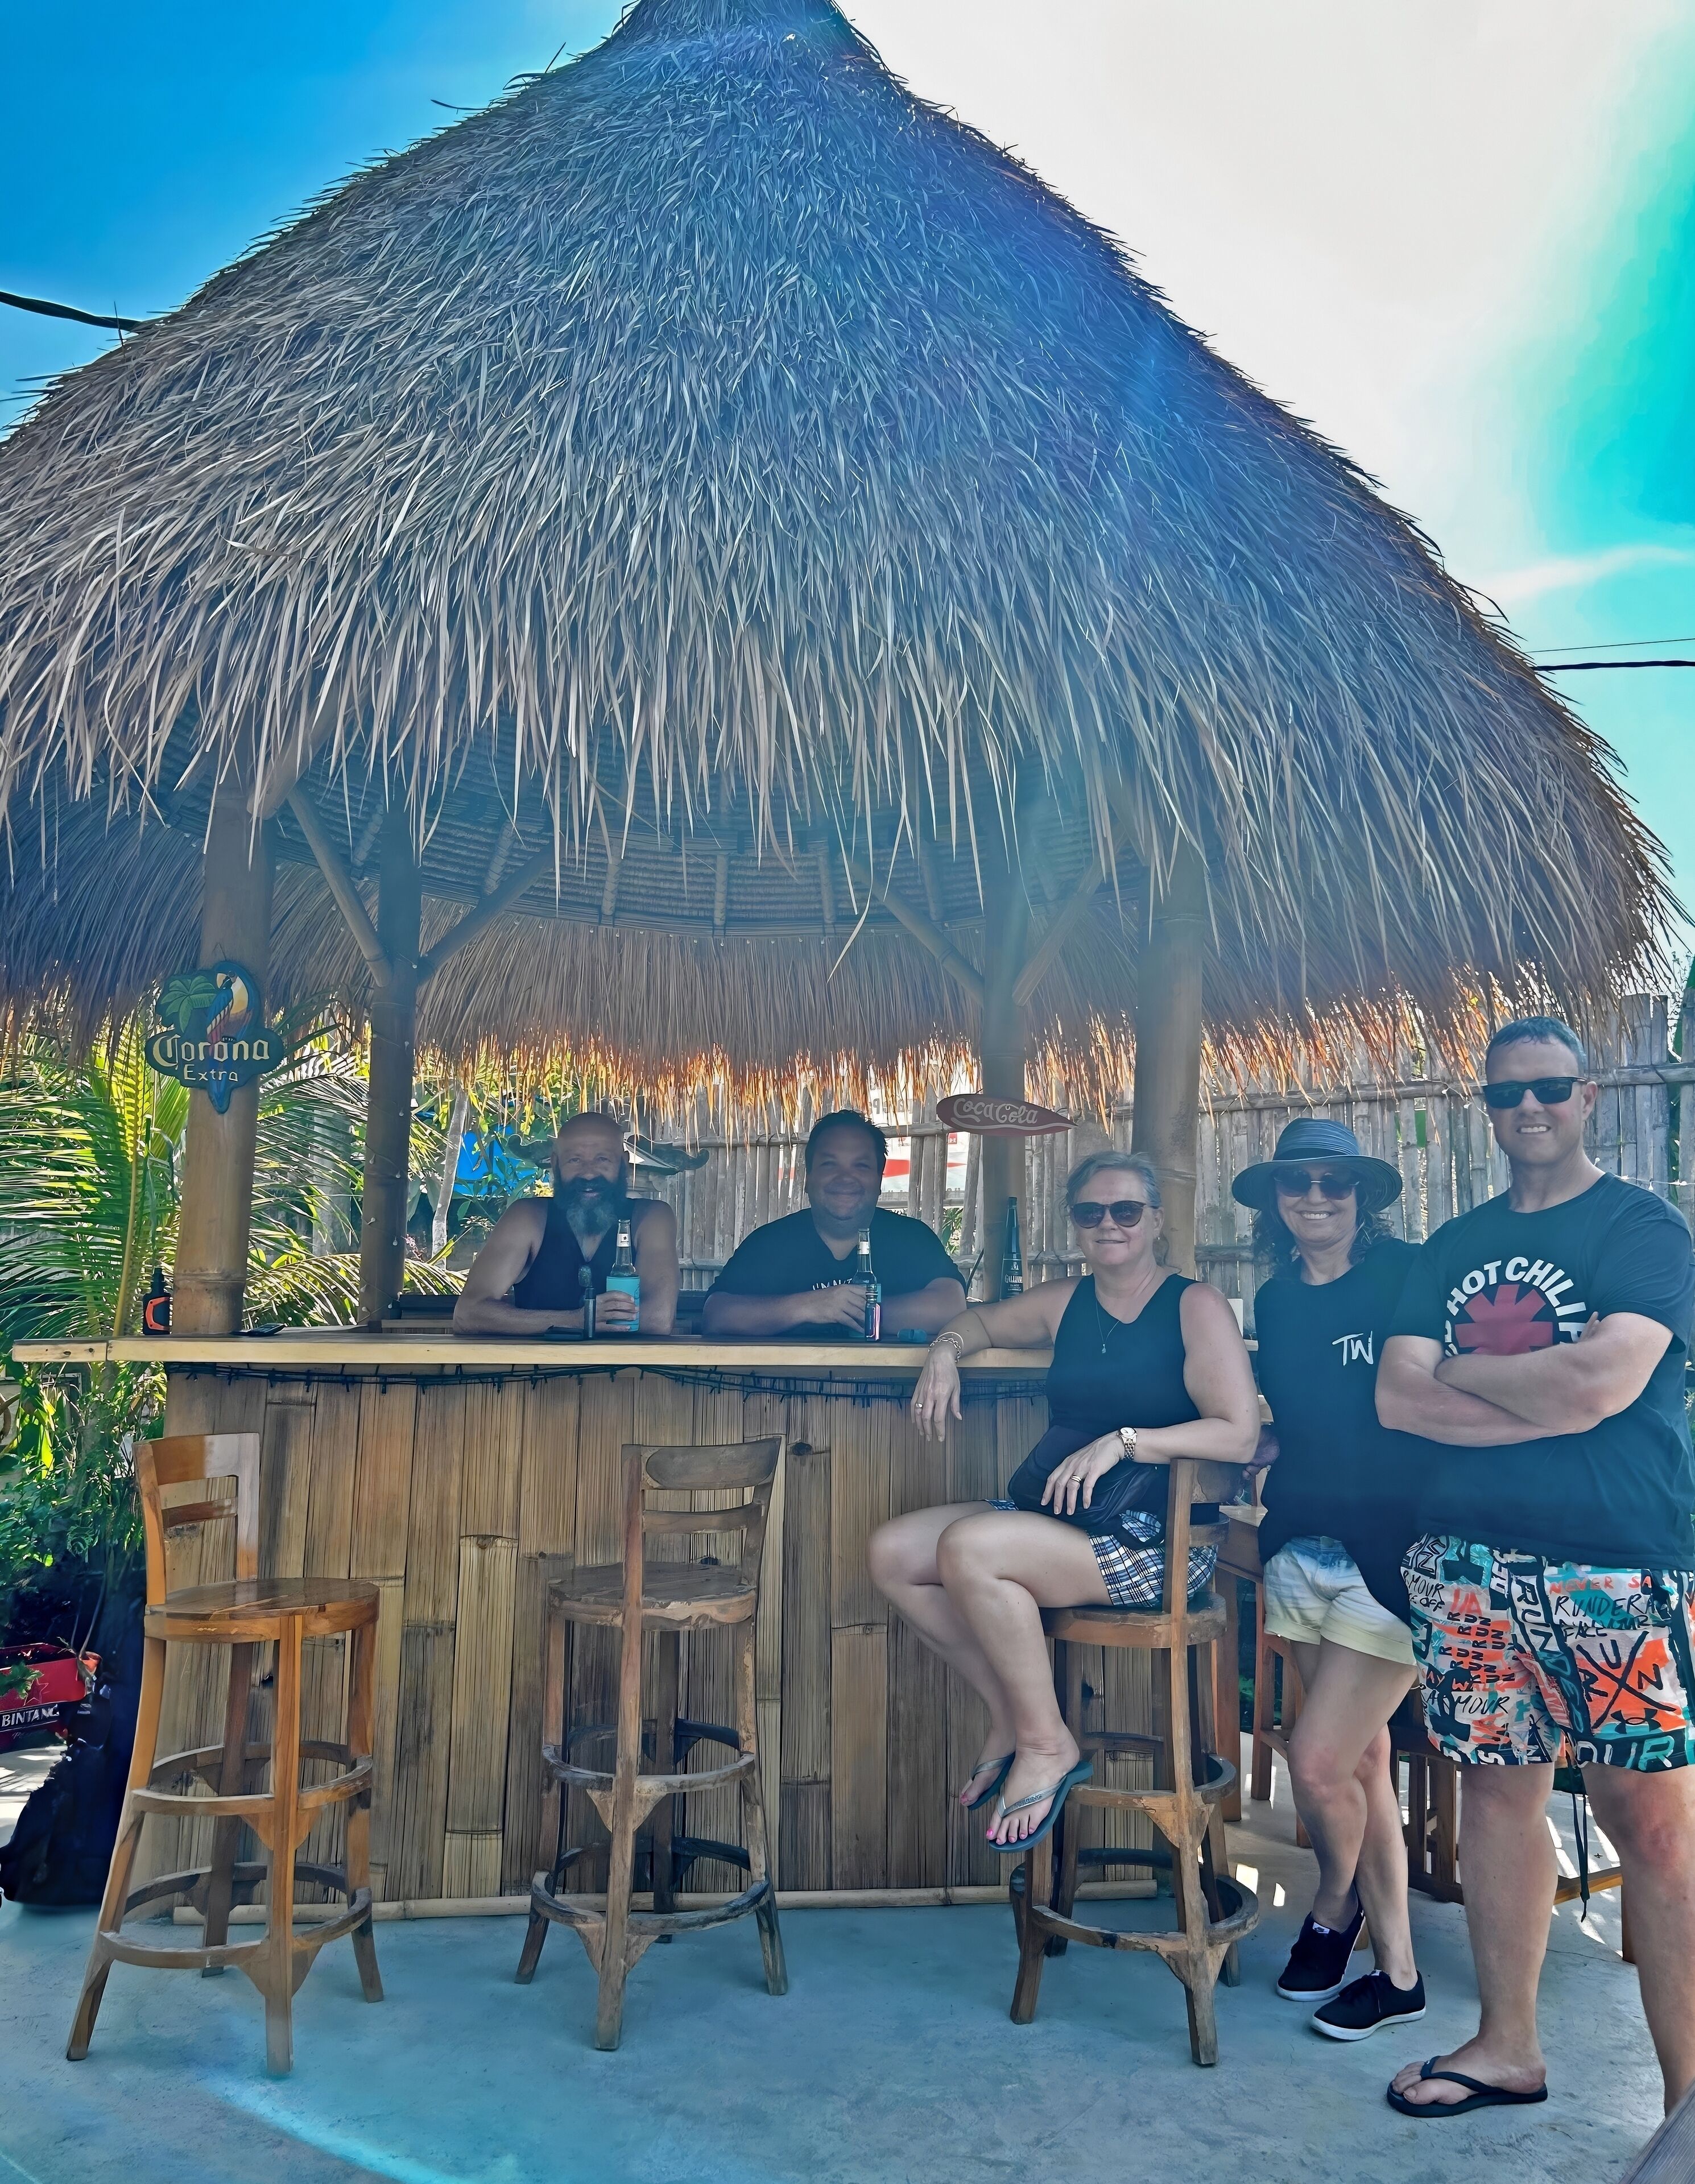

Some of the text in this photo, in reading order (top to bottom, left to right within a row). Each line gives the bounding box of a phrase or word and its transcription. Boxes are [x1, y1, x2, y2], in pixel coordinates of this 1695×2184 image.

[152, 1034, 270, 1070] Corona
[184, 1064, 238, 1082] Extra
[1446, 1256, 1587, 1317] HOT CHILI
[1550, 1576, 1614, 1594] NEVER
[2, 1703, 60, 1727] BINTANG
